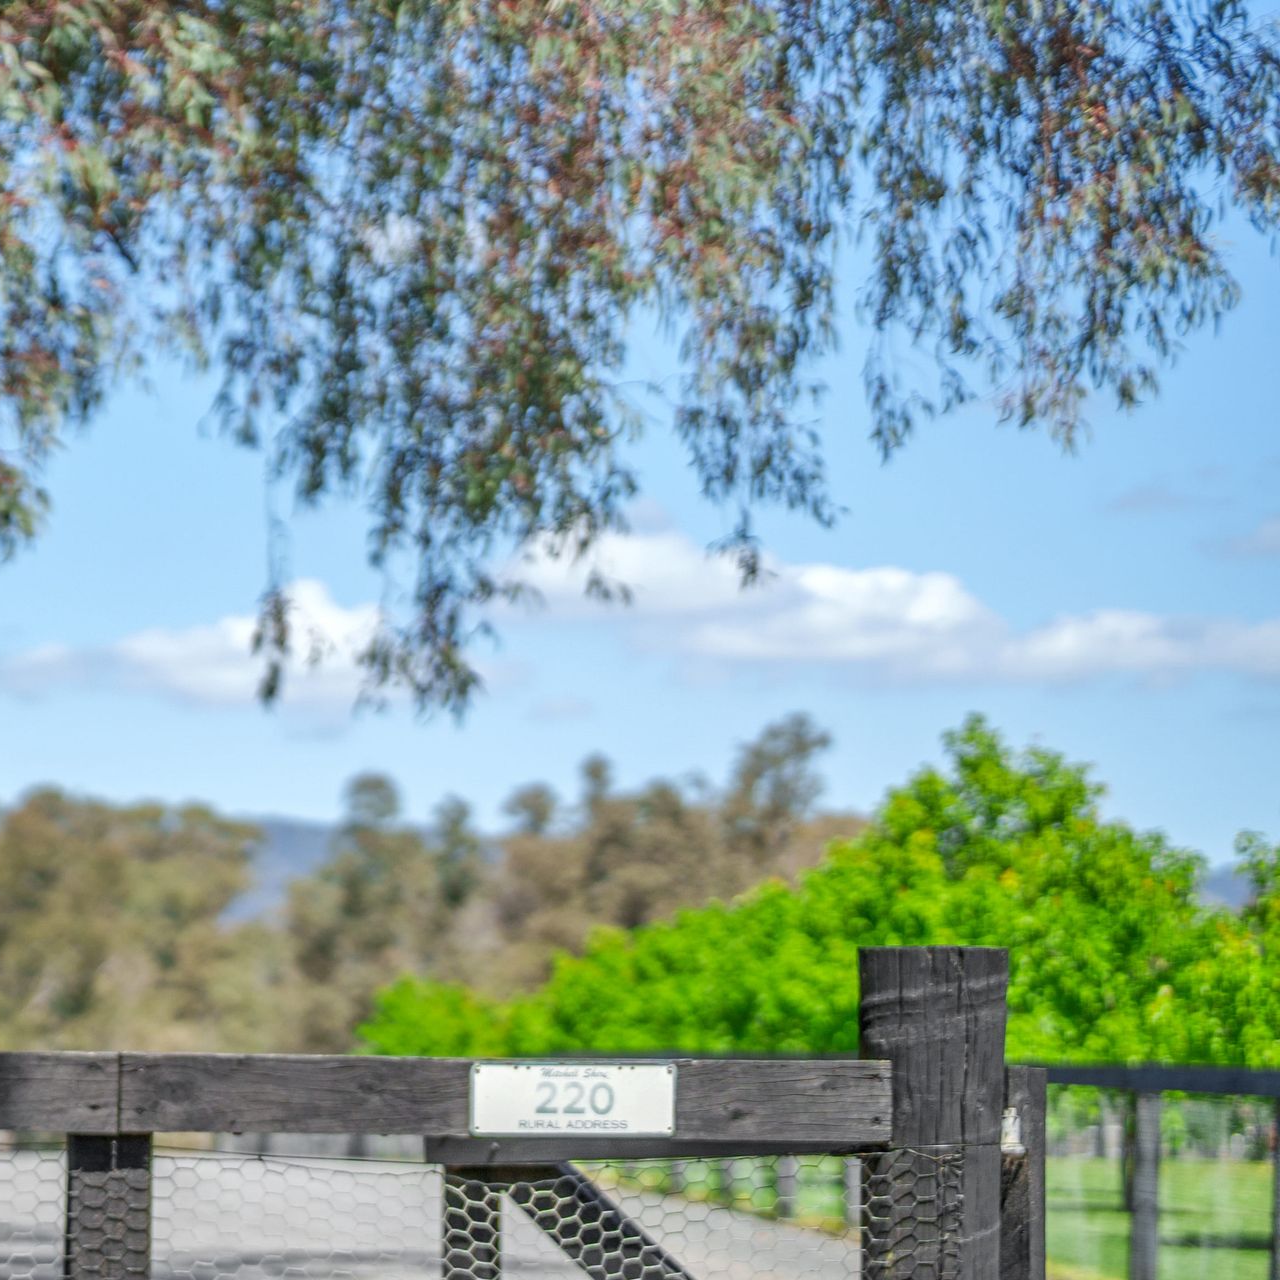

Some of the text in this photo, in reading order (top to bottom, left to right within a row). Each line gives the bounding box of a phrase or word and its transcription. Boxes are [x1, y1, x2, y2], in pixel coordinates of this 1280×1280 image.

[535, 1081, 615, 1115] 220
[518, 1119, 628, 1129] RURAL ADDRESS
